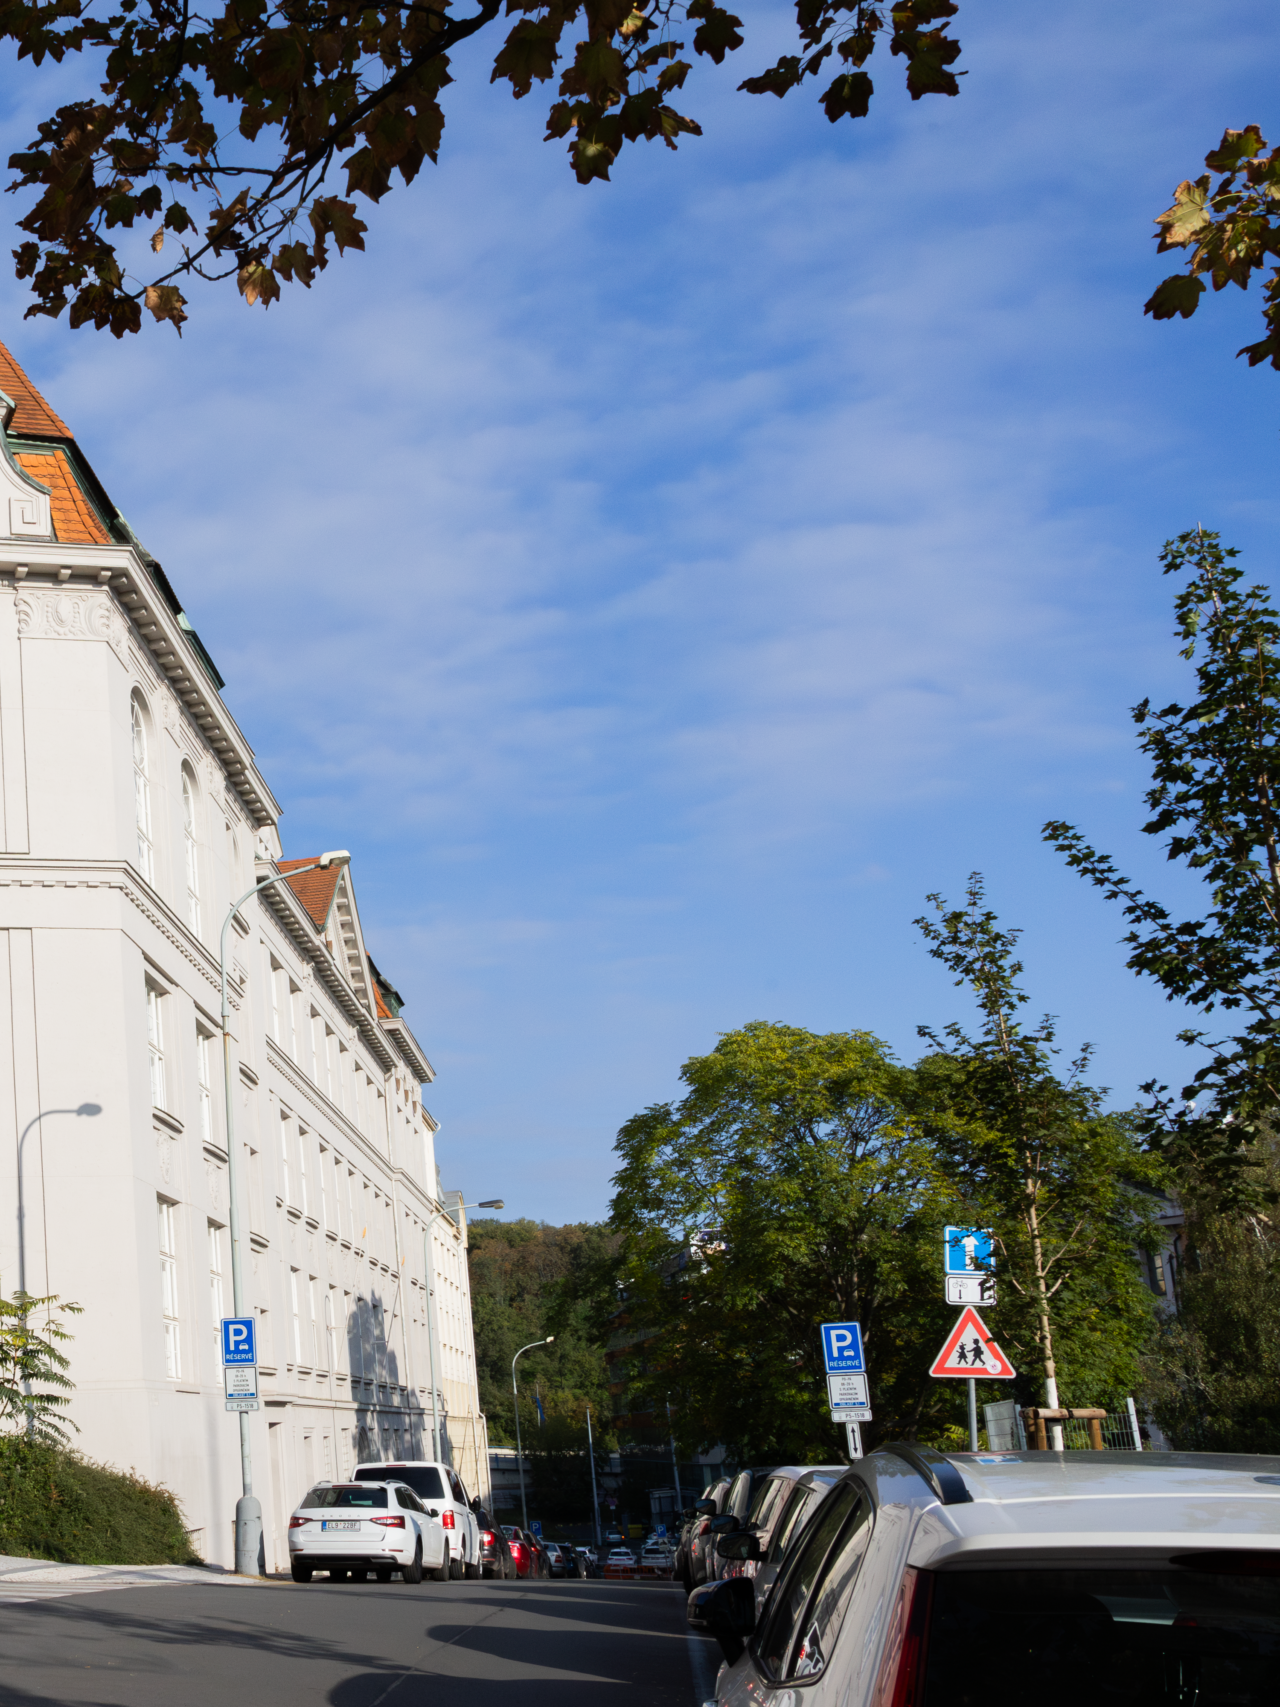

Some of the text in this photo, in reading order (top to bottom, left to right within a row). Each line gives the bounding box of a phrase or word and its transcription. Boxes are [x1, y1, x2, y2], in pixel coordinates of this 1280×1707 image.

[228, 1324, 248, 1351] P
[830, 1329, 852, 1358] P
[829, 1359, 860, 1368] RÉSERVÉ
[532, 1522, 539, 1532] P
[657, 1525, 664, 1534] P
